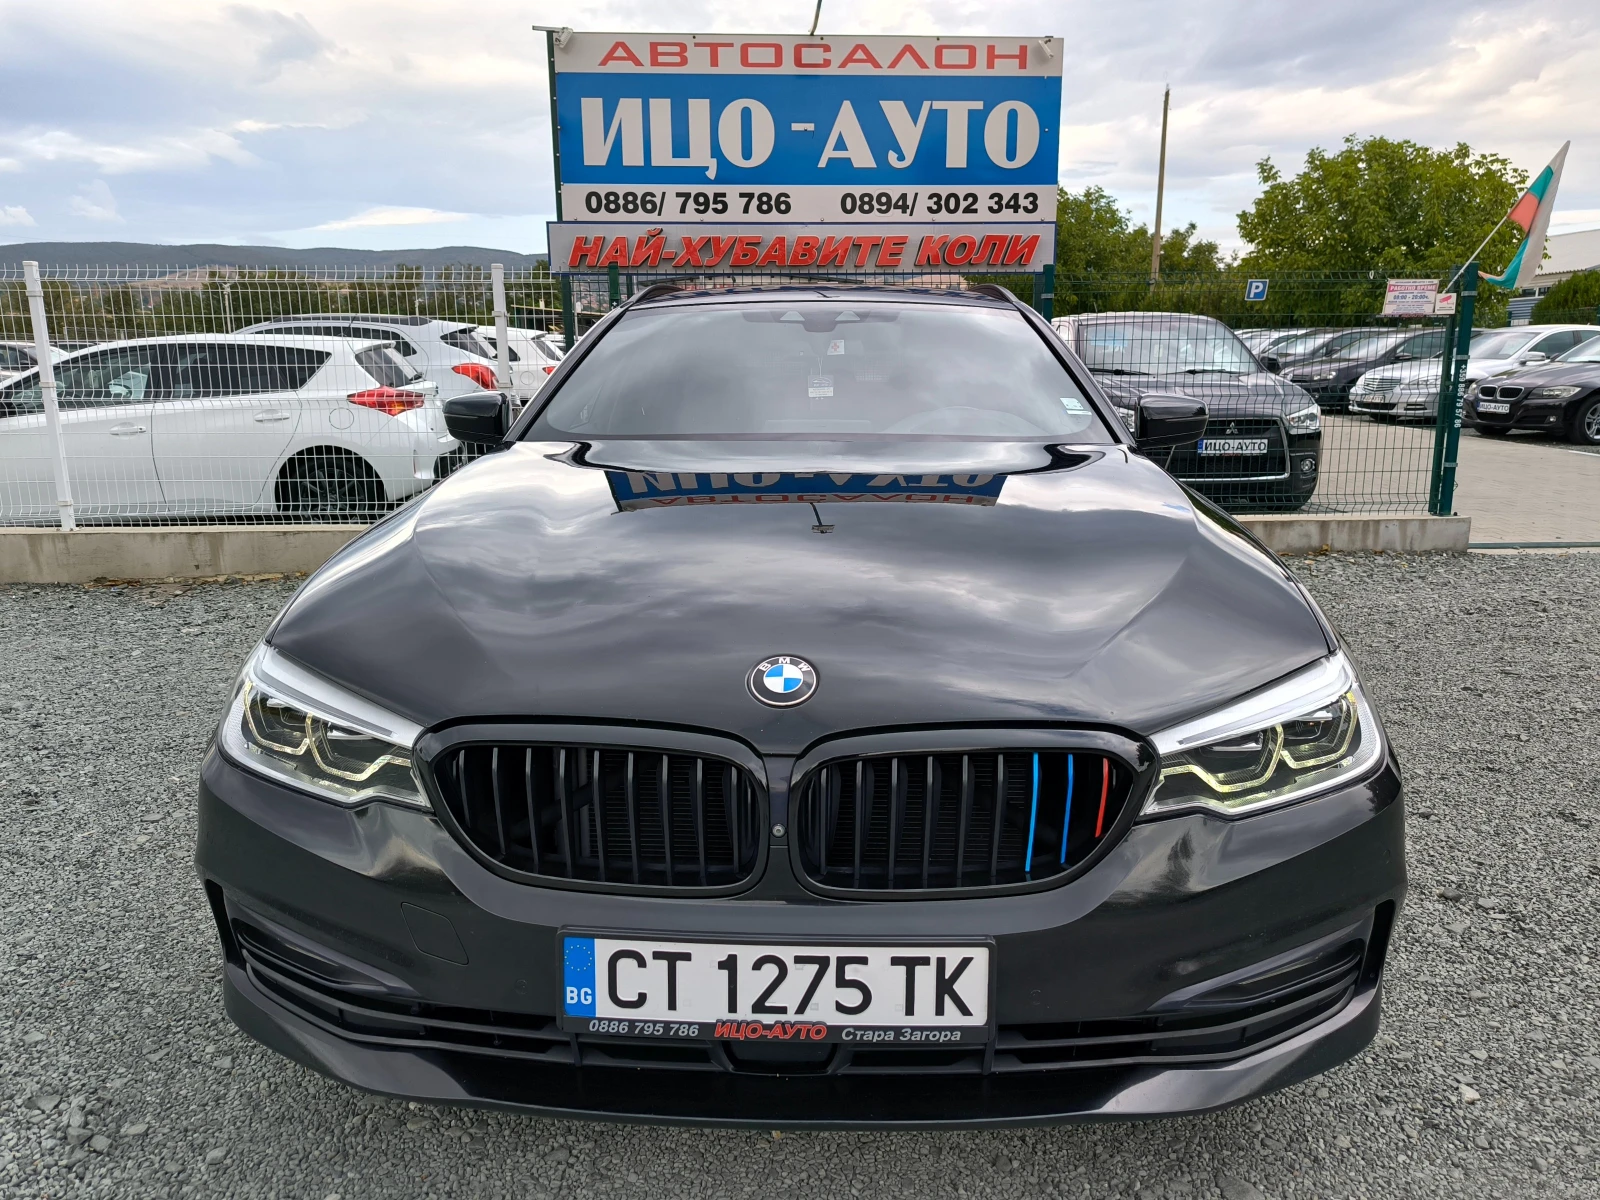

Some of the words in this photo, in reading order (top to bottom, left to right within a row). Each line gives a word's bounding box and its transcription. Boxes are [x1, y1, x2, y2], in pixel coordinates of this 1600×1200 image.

[598, 41, 1028, 70] АВТОСАЛОН
[585, 191, 665, 216] 0886/
[675, 191, 729, 215] 795
[738, 191, 792, 215] 786
[840, 192, 918, 217] 0894/
[926, 192, 978, 215] 302
[987, 192, 1040, 215] 343
[568, 228, 907, 268] НАЙ-ХУБАВИТЕ
[914, 234, 1042, 266] КОЛИ
[1250, 282, 1264, 298] P
[1205, 441, 1266, 453] ИЦО-АУТО
[759, 657, 811, 672] BMW
[717, 953, 873, 1016] 1275
[566, 986, 593, 1005] BG
[588, 1019, 629, 1034] 0886
[634, 1022, 664, 1036] 795
[668, 1023, 699, 1037] 786
[714, 1020, 827, 1040] ИЦО-АУТО
[841, 1027, 895, 1042] Стара
[899, 1028, 961, 1043] Загора
